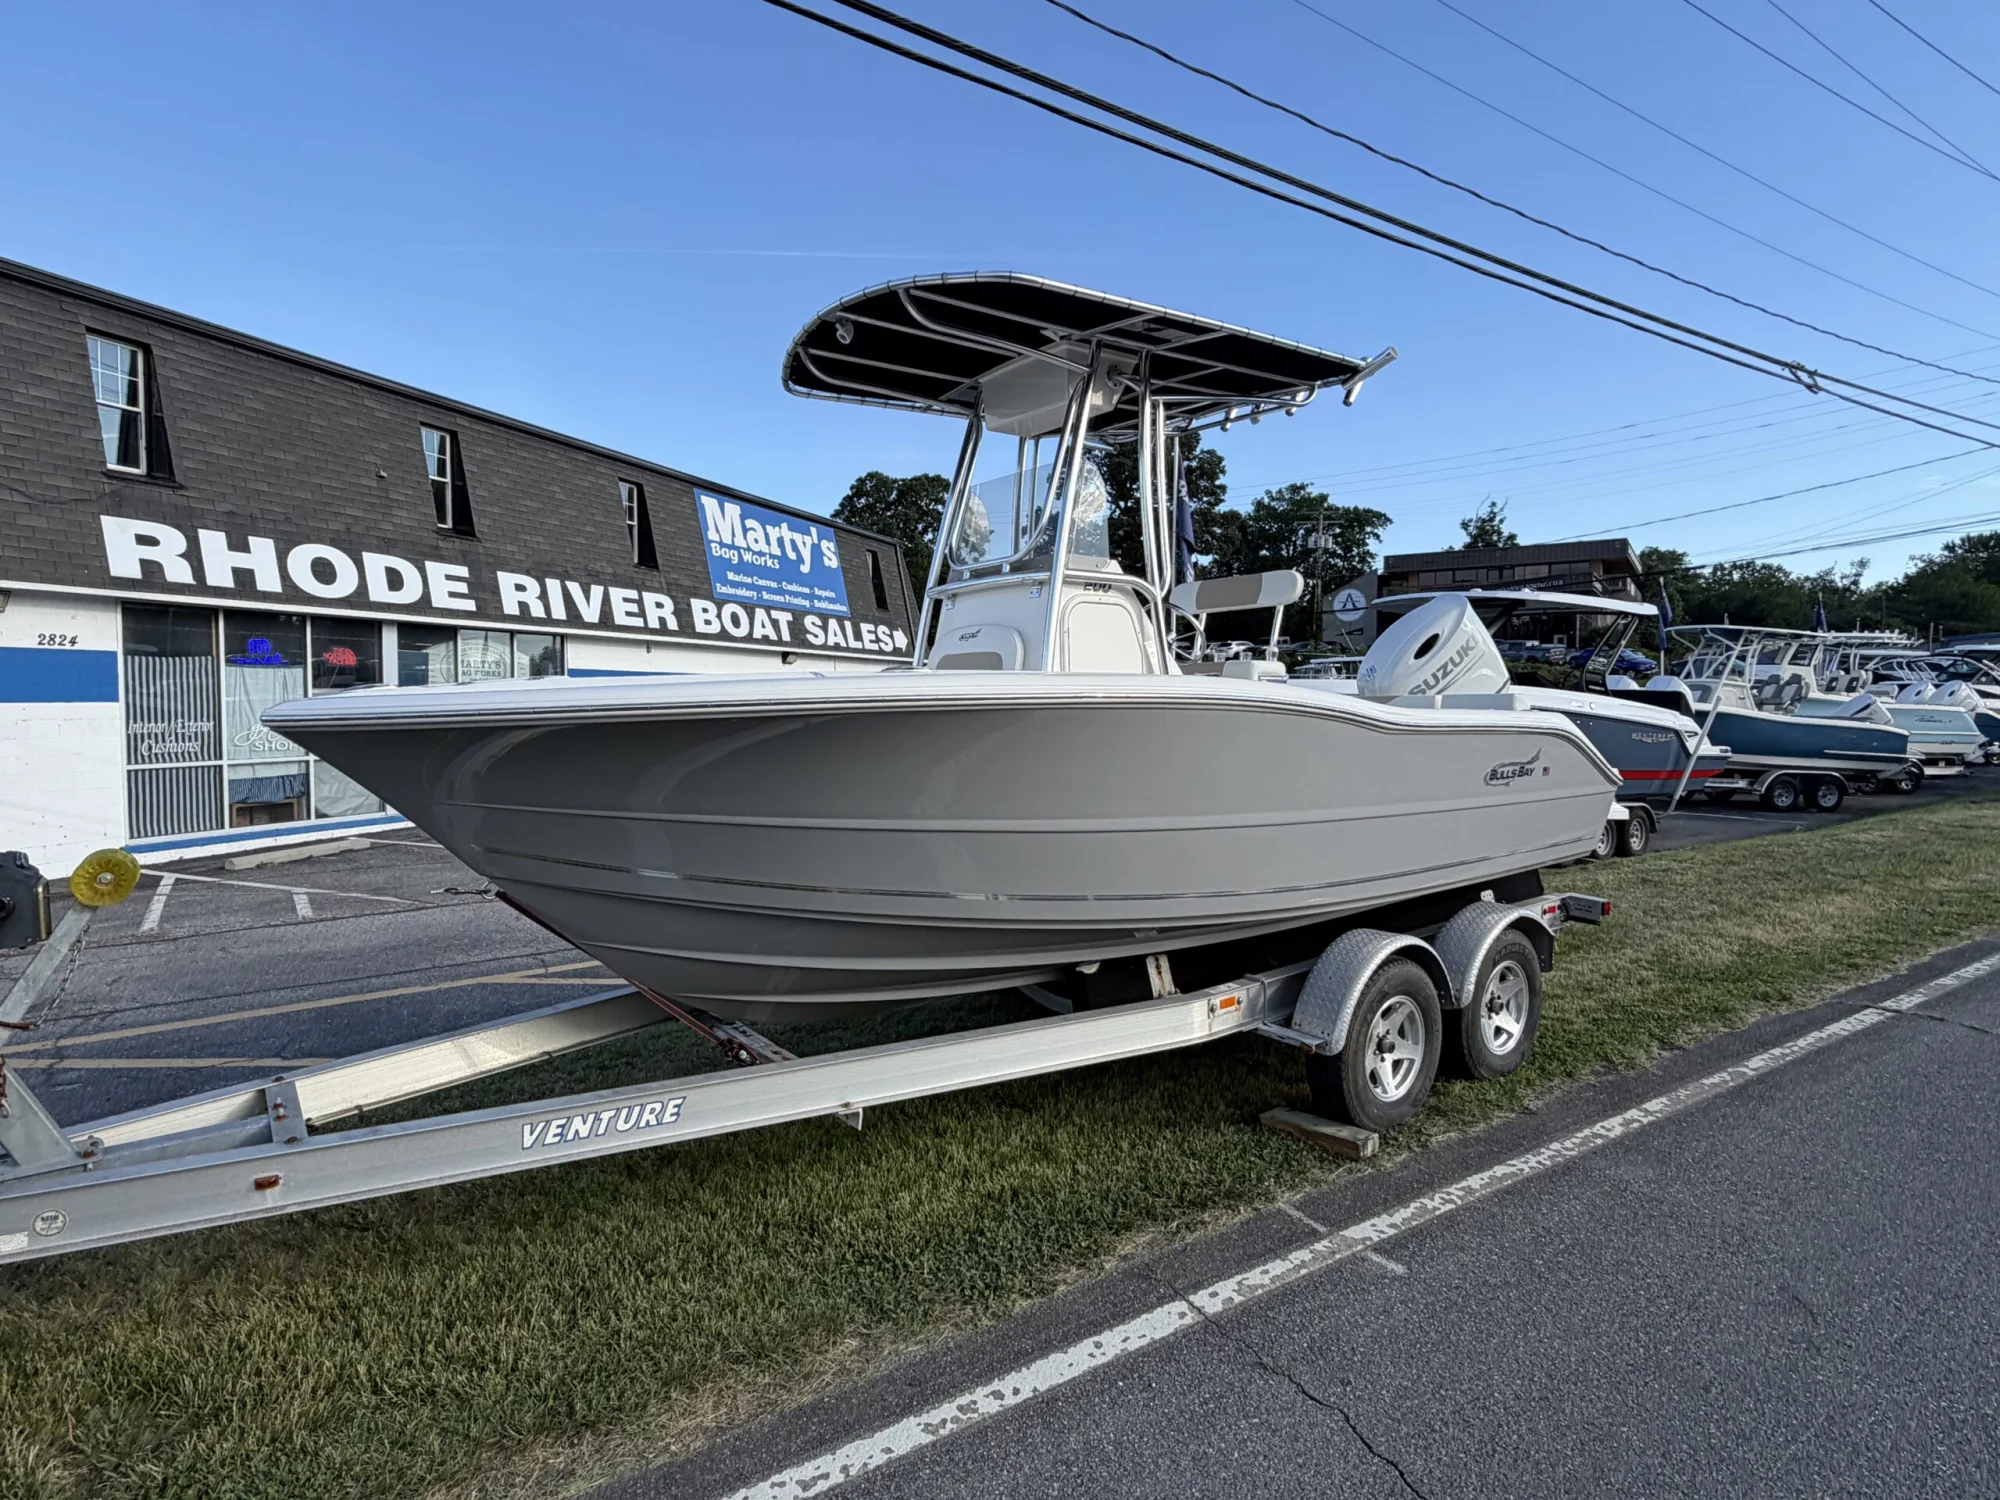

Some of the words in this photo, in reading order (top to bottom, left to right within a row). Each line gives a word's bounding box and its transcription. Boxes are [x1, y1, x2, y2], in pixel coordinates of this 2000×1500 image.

[700, 495, 839, 574] Marty's
[710, 542, 738, 564] Bag
[740, 548, 780, 569] Works
[100, 514, 477, 611] RHODE
[497, 571, 679, 631] RIVER
[690, 598, 794, 642] BOAT
[803, 615, 895, 653] SALES
[716, 583, 757, 600] Embroidery
[762, 591, 785, 602] Screen
[786, 595, 810, 608] Printing
[814, 599, 848, 612] Sublimation
[726, 570, 752, 584] Marine
[752, 575, 778, 588] Canvas
[782, 581, 810, 594] Cushions
[814, 587, 836, 598] Repairs
[37, 633, 79, 647] 2824
[1408, 634, 1479, 695] SUZUKI
[141, 736, 201, 756] Cushions
[521, 1096, 687, 1150] VENTURE
